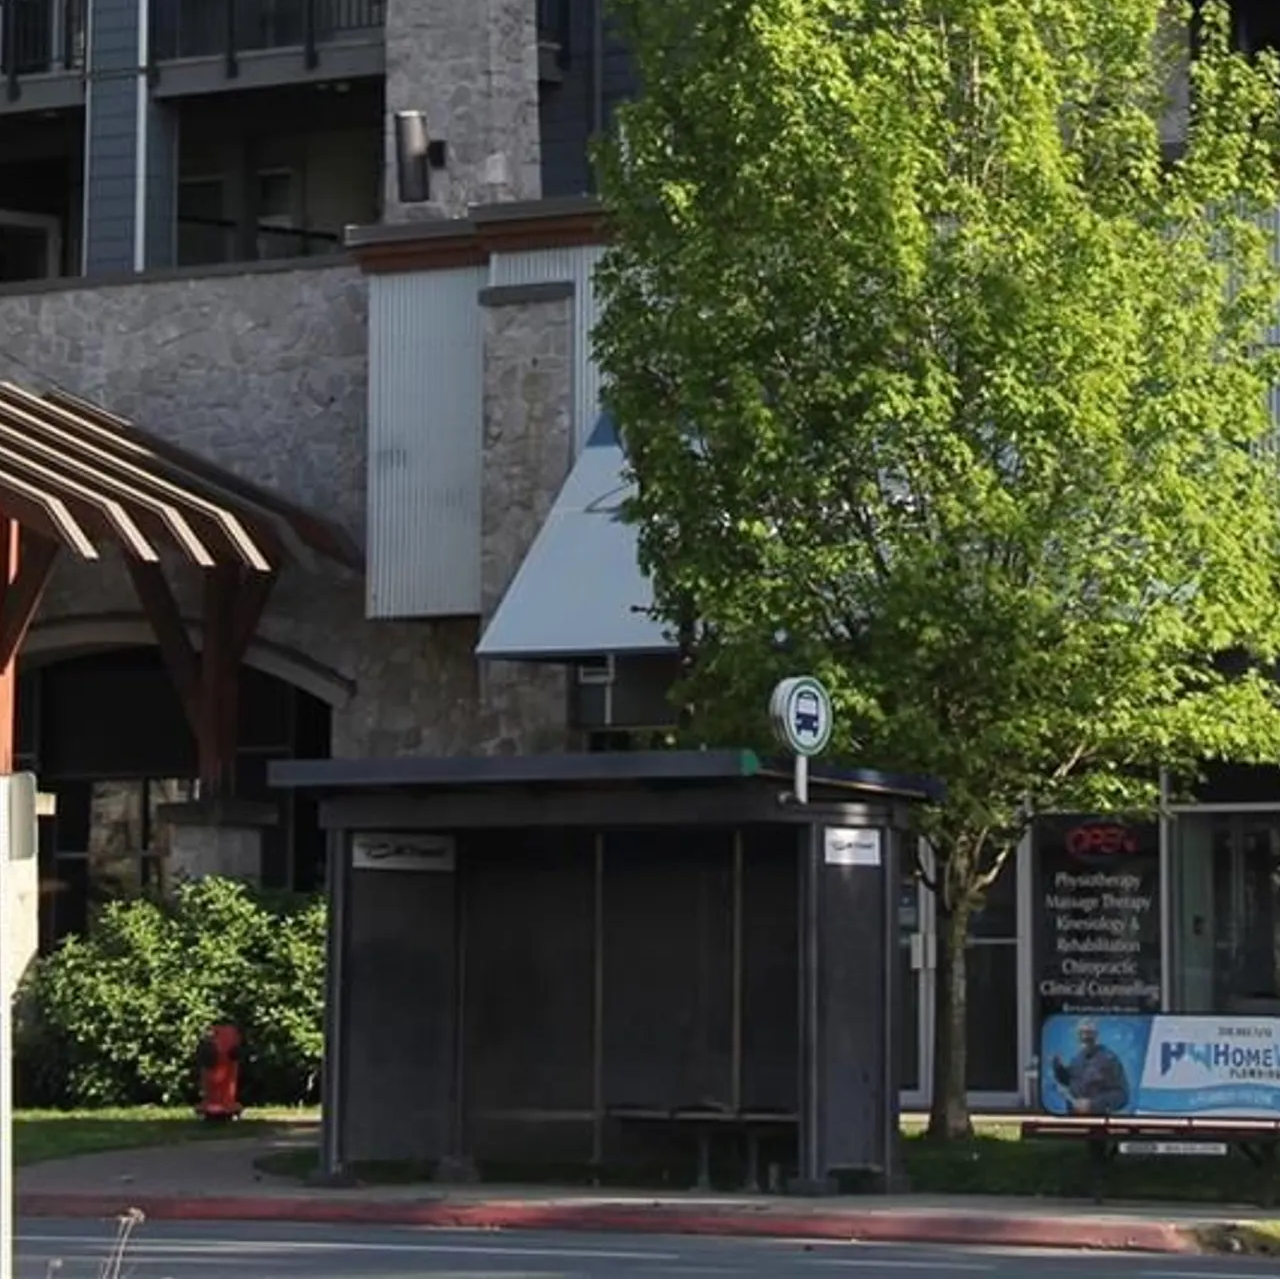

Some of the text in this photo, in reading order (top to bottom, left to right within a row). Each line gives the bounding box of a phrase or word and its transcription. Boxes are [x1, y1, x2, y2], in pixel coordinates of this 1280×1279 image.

[1065, 826, 1140, 855] OPEN
[1054, 872, 1140, 892] Physiotherapy
[1045, 893, 1098, 913] Massage
[1056, 937, 1140, 953] Rehabilitation
[1062, 959, 1137, 977] Chiropractic
